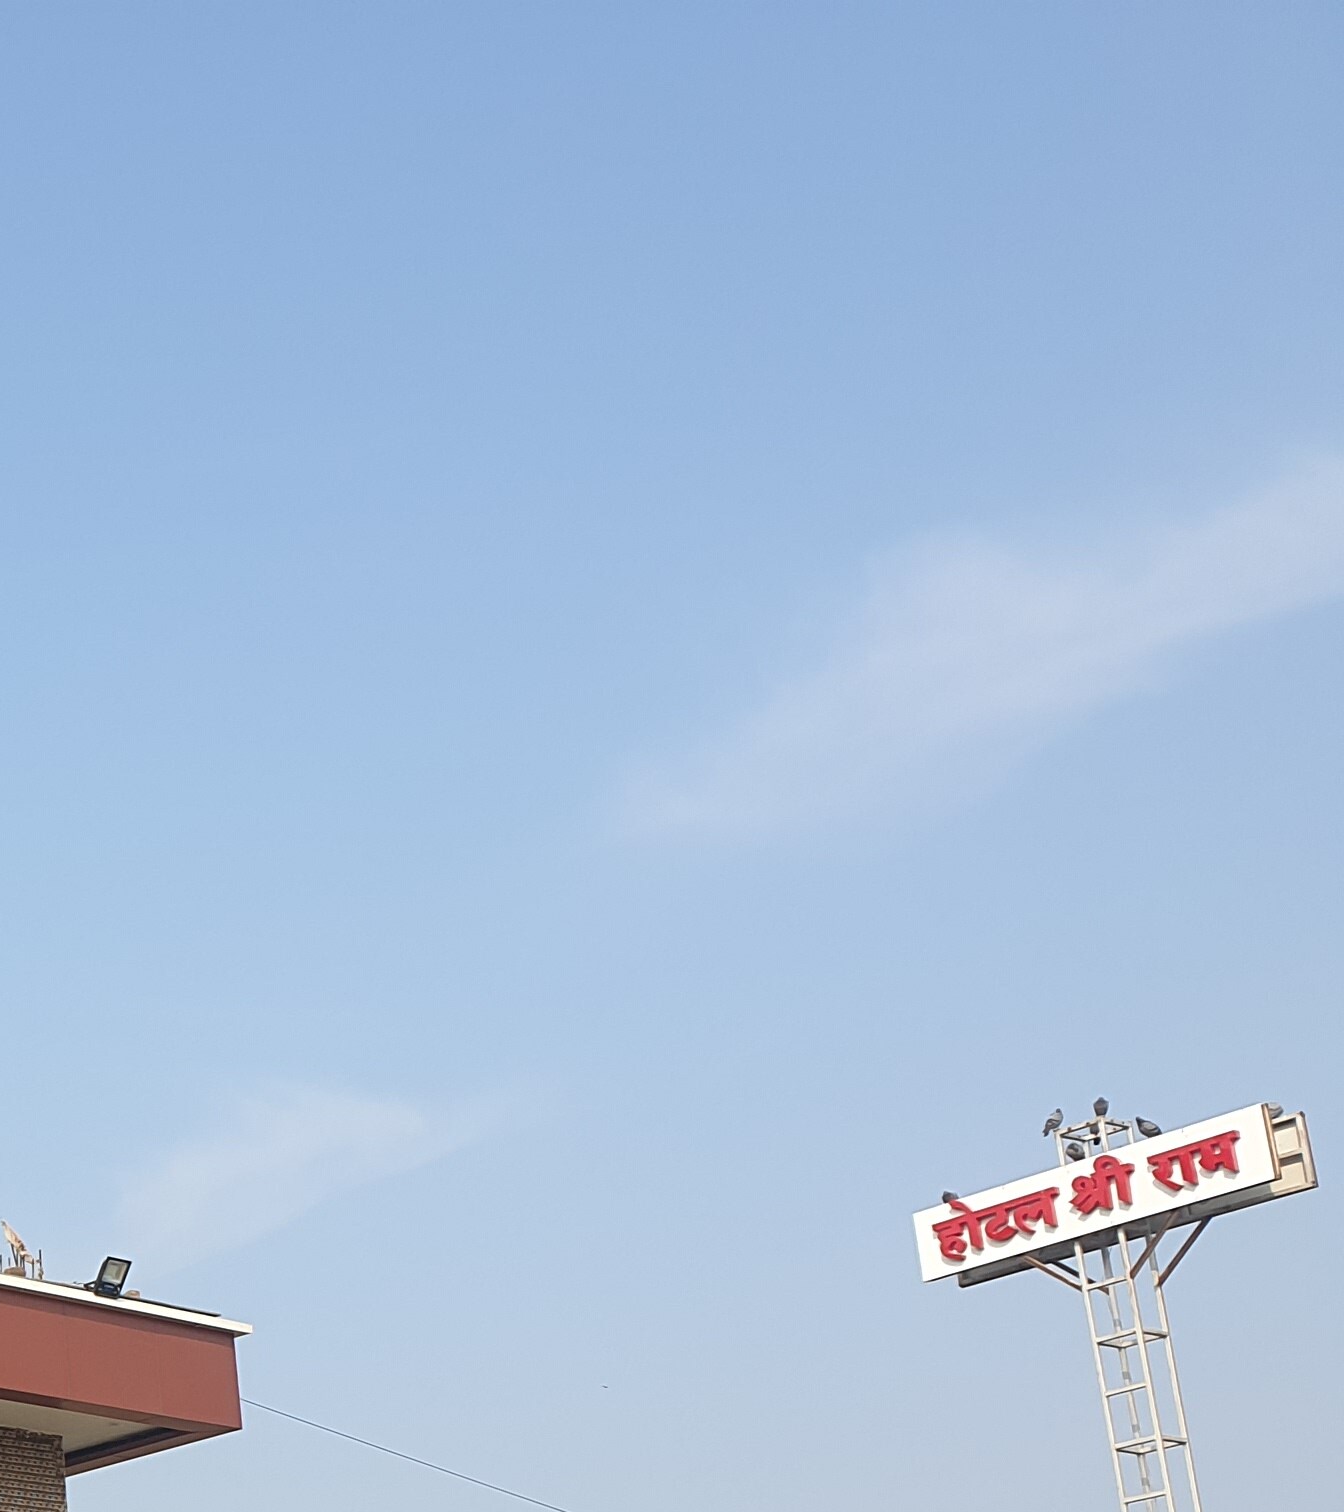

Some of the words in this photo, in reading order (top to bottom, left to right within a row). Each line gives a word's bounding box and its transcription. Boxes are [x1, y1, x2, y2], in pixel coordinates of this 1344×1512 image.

[931, 1186, 1060, 1262] होटल
[1070, 1154, 1135, 1215] श्री
[1146, 1130, 1240, 1192] राम
